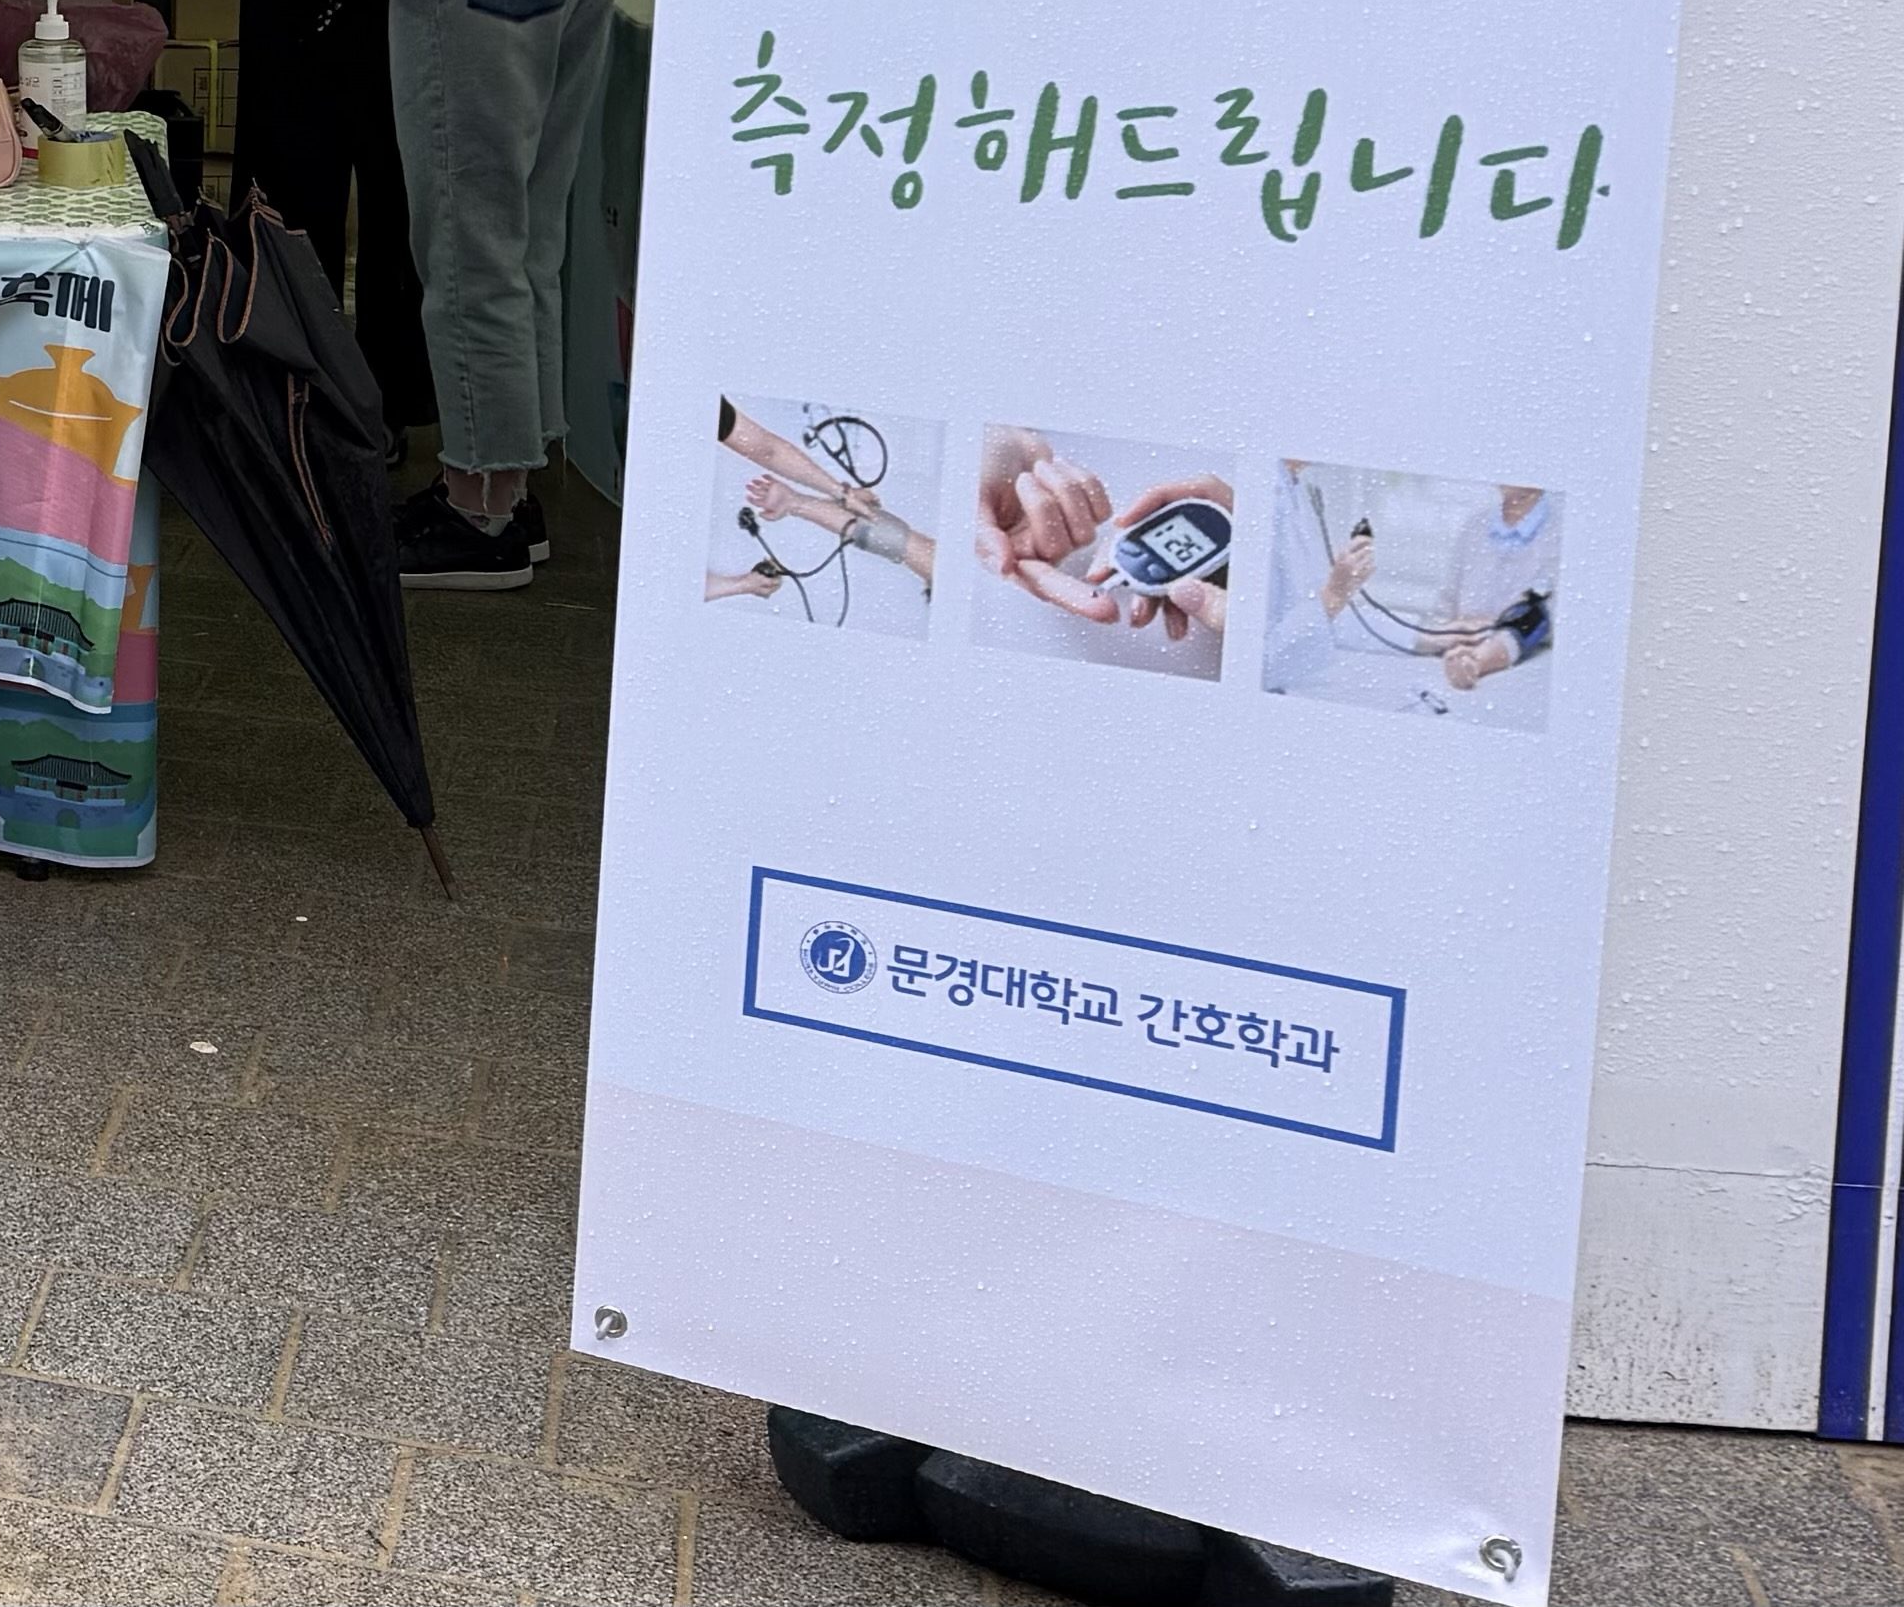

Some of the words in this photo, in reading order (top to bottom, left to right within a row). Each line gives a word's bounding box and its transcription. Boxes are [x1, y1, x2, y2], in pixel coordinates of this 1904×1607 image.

[731, 30, 1611, 252] 측정해드립니다
[886, 943, 1124, 1027] 문경대학교
[1136, 993, 1341, 1074] 간호학과
